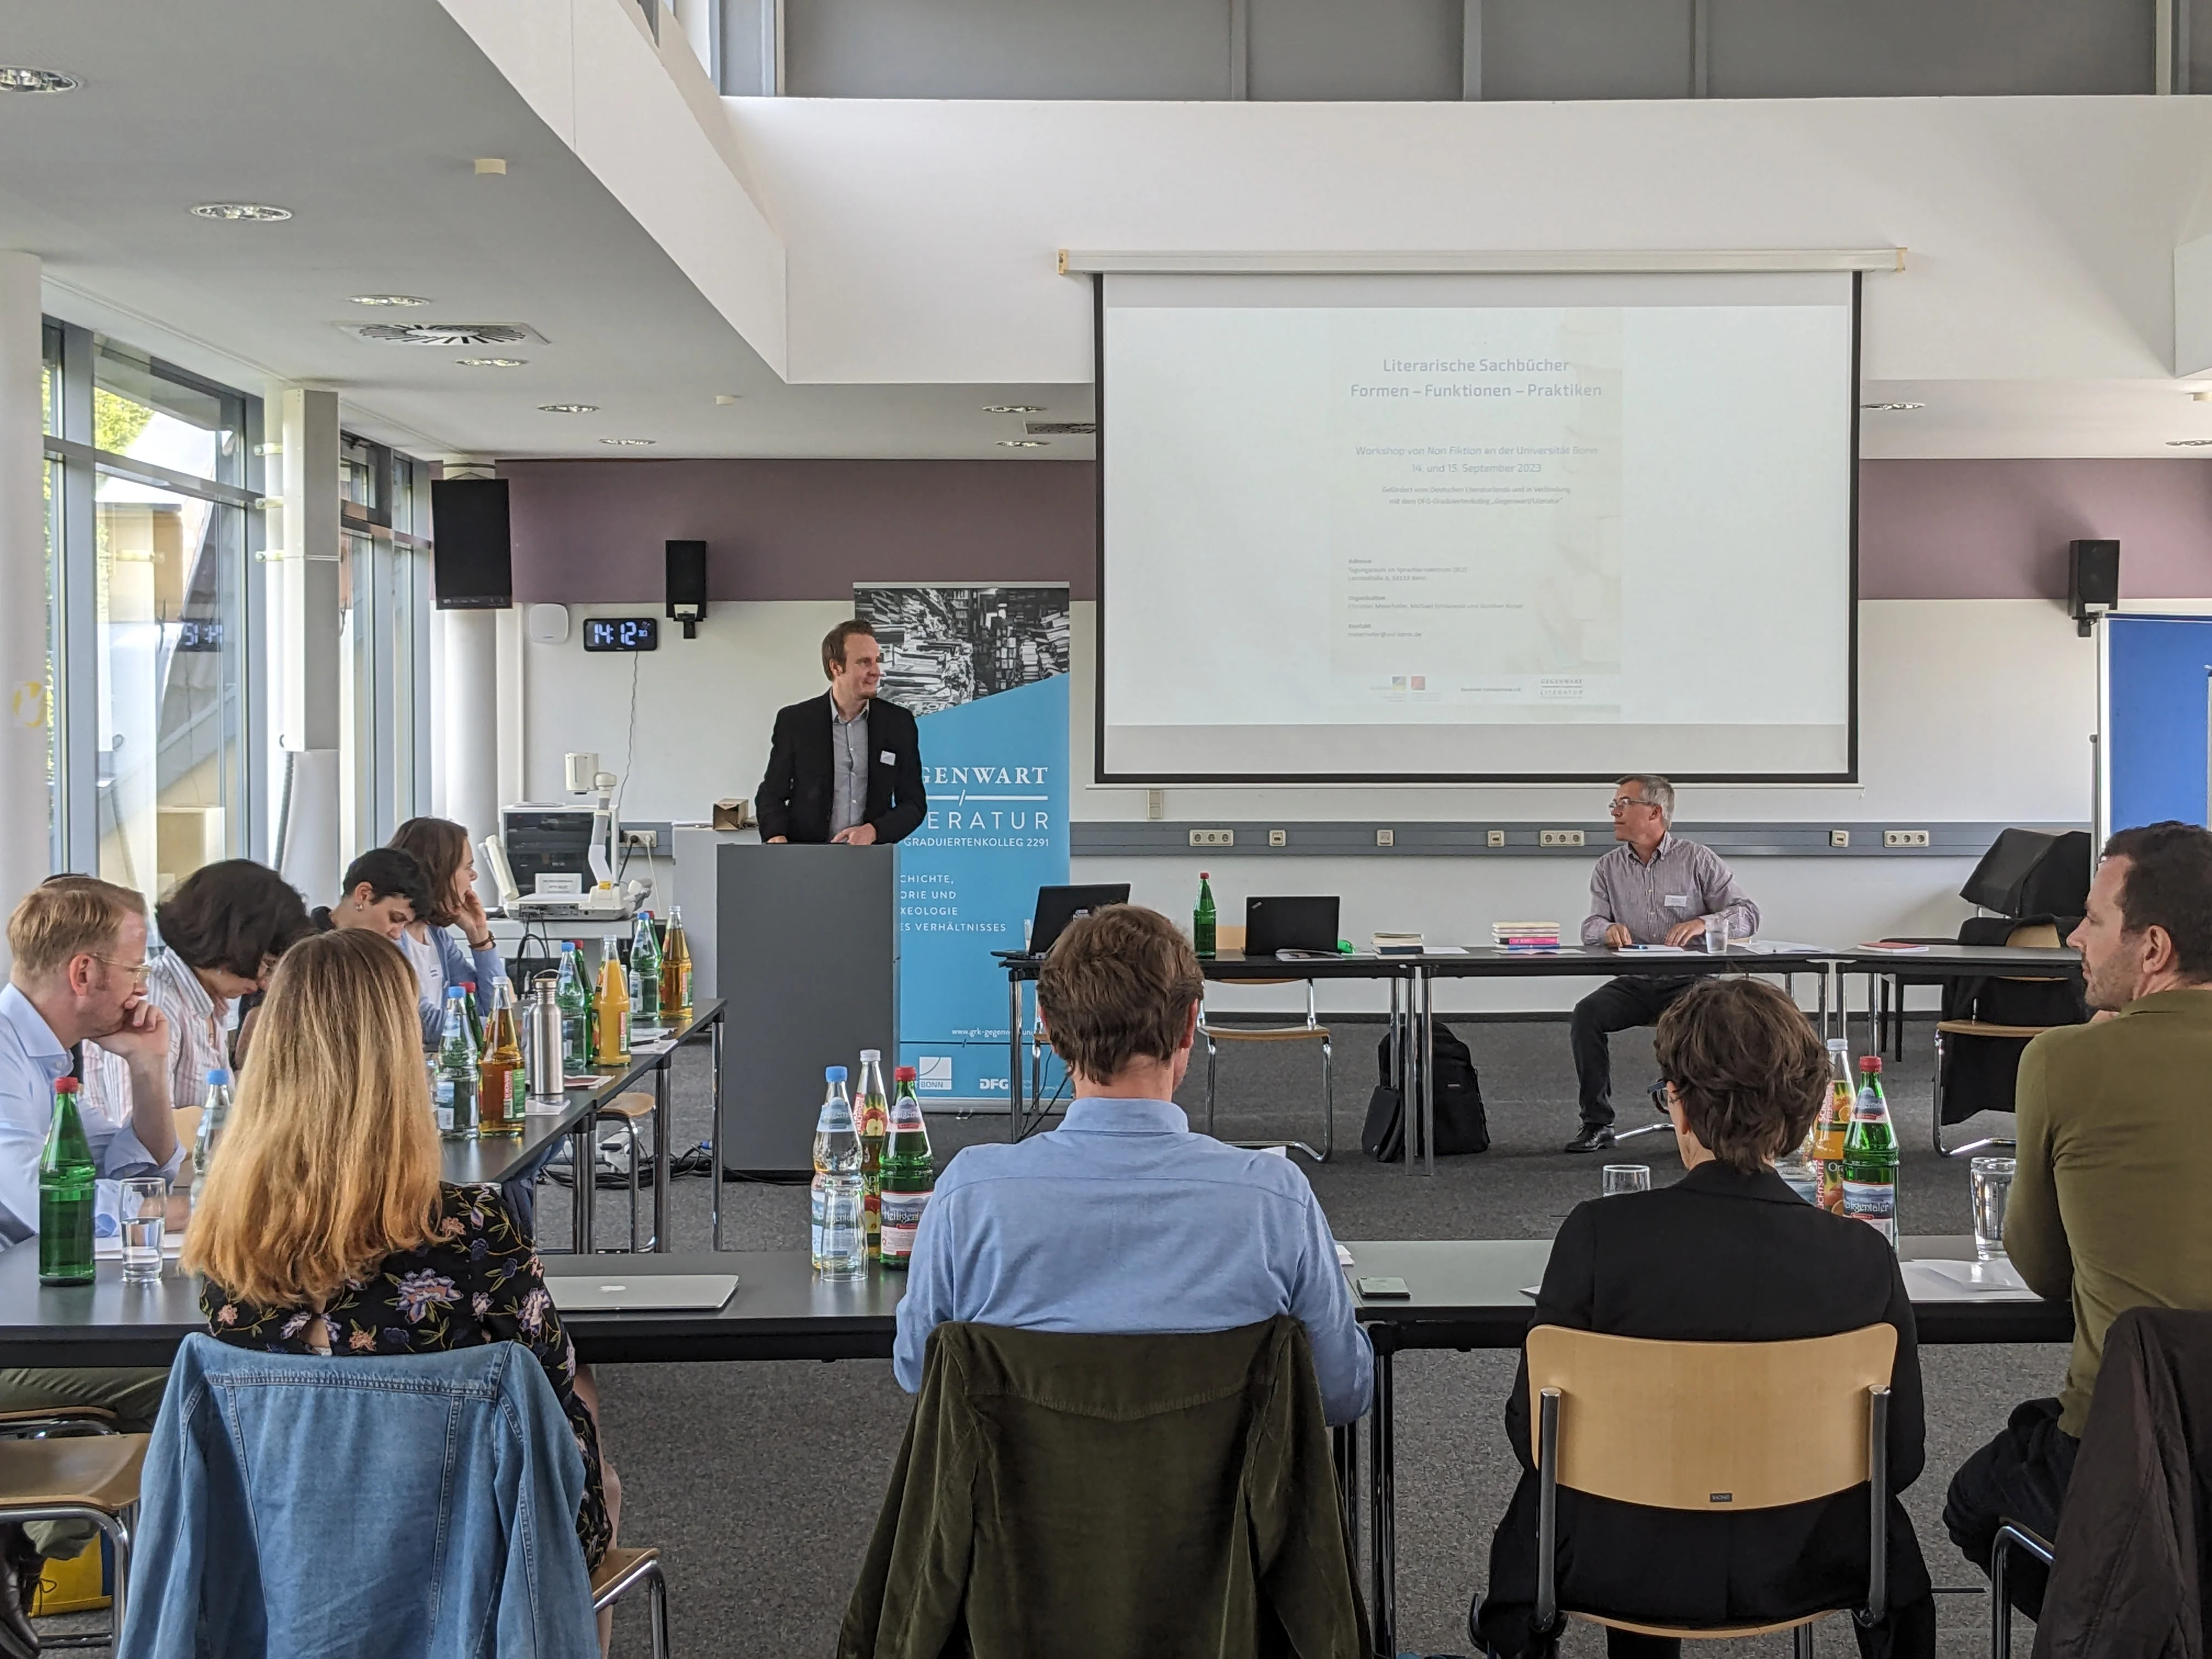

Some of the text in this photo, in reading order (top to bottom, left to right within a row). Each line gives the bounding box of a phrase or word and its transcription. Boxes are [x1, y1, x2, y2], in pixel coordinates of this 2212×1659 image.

[1383, 358, 1571, 372] Literarische Sachbücher
[1351, 384, 1409, 397] Formen
[1425, 384, 1511, 397] Funktionen
[1527, 383, 1602, 396] Praktiken
[1355, 446, 1404, 456] Workshop
[1427, 446, 1447, 455] Non
[1449, 446, 1481, 455] Fiktion
[1498, 446, 1514, 455] der
[1516, 446, 1570, 455] Universität
[1572, 446, 1598, 455] Bonn
[1427, 464, 1444, 472] und
[1462, 464, 1515, 475] September
[1517, 464, 1541, 473] 2023
[922, 766, 1049, 785] GENWART
[927, 811, 1049, 830] ERATUR
[1026, 838, 1049, 847] 2291
[900, 874, 955, 885] CHICHTE,
[900, 890, 957, 900] ORIE UND
[900, 906, 958, 916] XEOLOGIE
[915, 921, 1007, 932] VERHÄLTNISSES
[979, 1078, 1009, 1090] DFG
